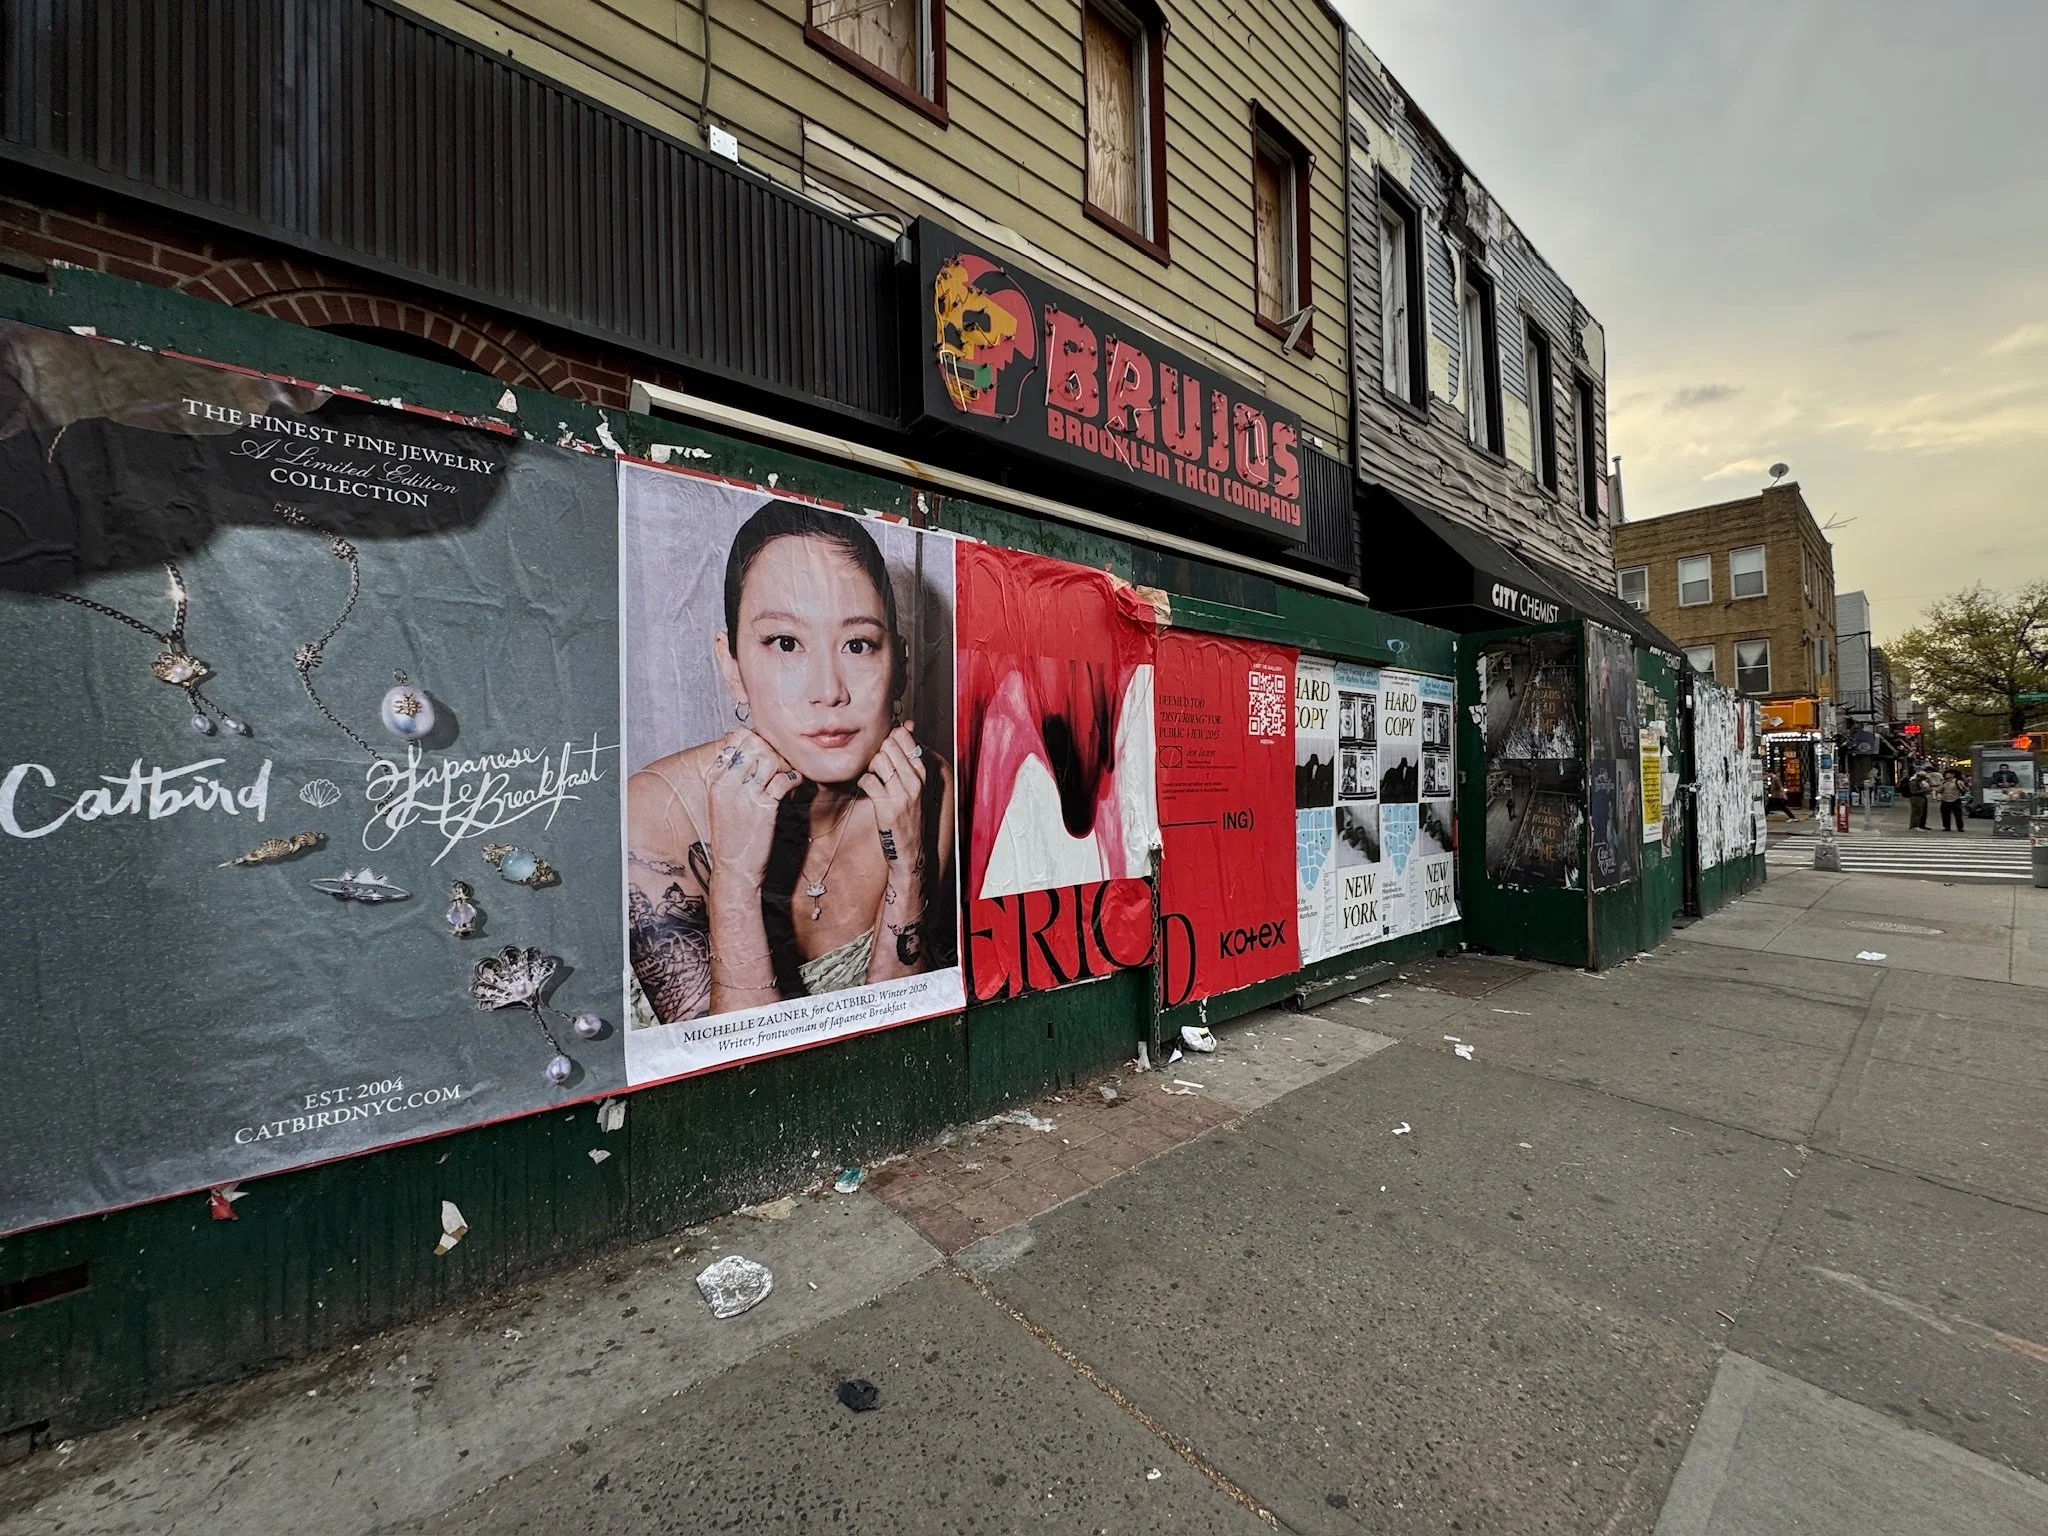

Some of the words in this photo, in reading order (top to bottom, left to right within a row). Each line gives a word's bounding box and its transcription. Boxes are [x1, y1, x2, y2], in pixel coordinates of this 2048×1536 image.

[1044, 303, 1300, 500] BRUJOS
[182, 398, 243, 425] THE
[250, 412, 339, 444] FINEST
[344, 433, 396, 456] FINE
[398, 443, 496, 475] JEWELRY
[229, 439, 281, 460] A
[275, 442, 377, 478] Limited
[376, 461, 459, 495] Edition
[270, 467, 428, 508] COLLECTION
[1047, 407, 1170, 480] BROOKLYN
[1175, 459, 1220, 498] TACO
[1223, 477, 1301, 527] COMPANY
[1492, 583, 1518, 612] CITY
[1519, 593, 1560, 624] CHEMIST
[1384, 691, 1417, 713] HARD
[1159, 727, 1185, 739] PUBLIC
[1385, 716, 1415, 737] COPY
[0, 757, 273, 838] Catbird
[362, 740, 547, 851] Japanese
[1222, 808, 1254, 831] ING)
[1531, 814, 1561, 827] ROADS
[1344, 873, 1376, 900] NEW
[1426, 861, 1449, 885] NEW
[1343, 900, 1379, 929] YORK
[1424, 885, 1451, 910] YORK
[683, 1018, 756, 1044] MICHELLE
[757, 1008, 810, 1027] ZAUNER
[810, 1004, 826, 1019] for
[826, 993, 877, 1013] CATBIRD,
[879, 988, 908, 1001] Winter
[909, 981, 929, 995] 2026
[718, 1036, 756, 1052] Writer,
[756, 1021, 817, 1046] frontwoman
[819, 1018, 829, 1032] of
[829, 1010, 868, 1030] Japanese
[869, 1000, 908, 1018] Breakfast
[304, 1088, 353, 1111] EST.
[357, 1076, 404, 1100] 2004
[235, 1084, 462, 1145] CATBIRDNYC.COM
